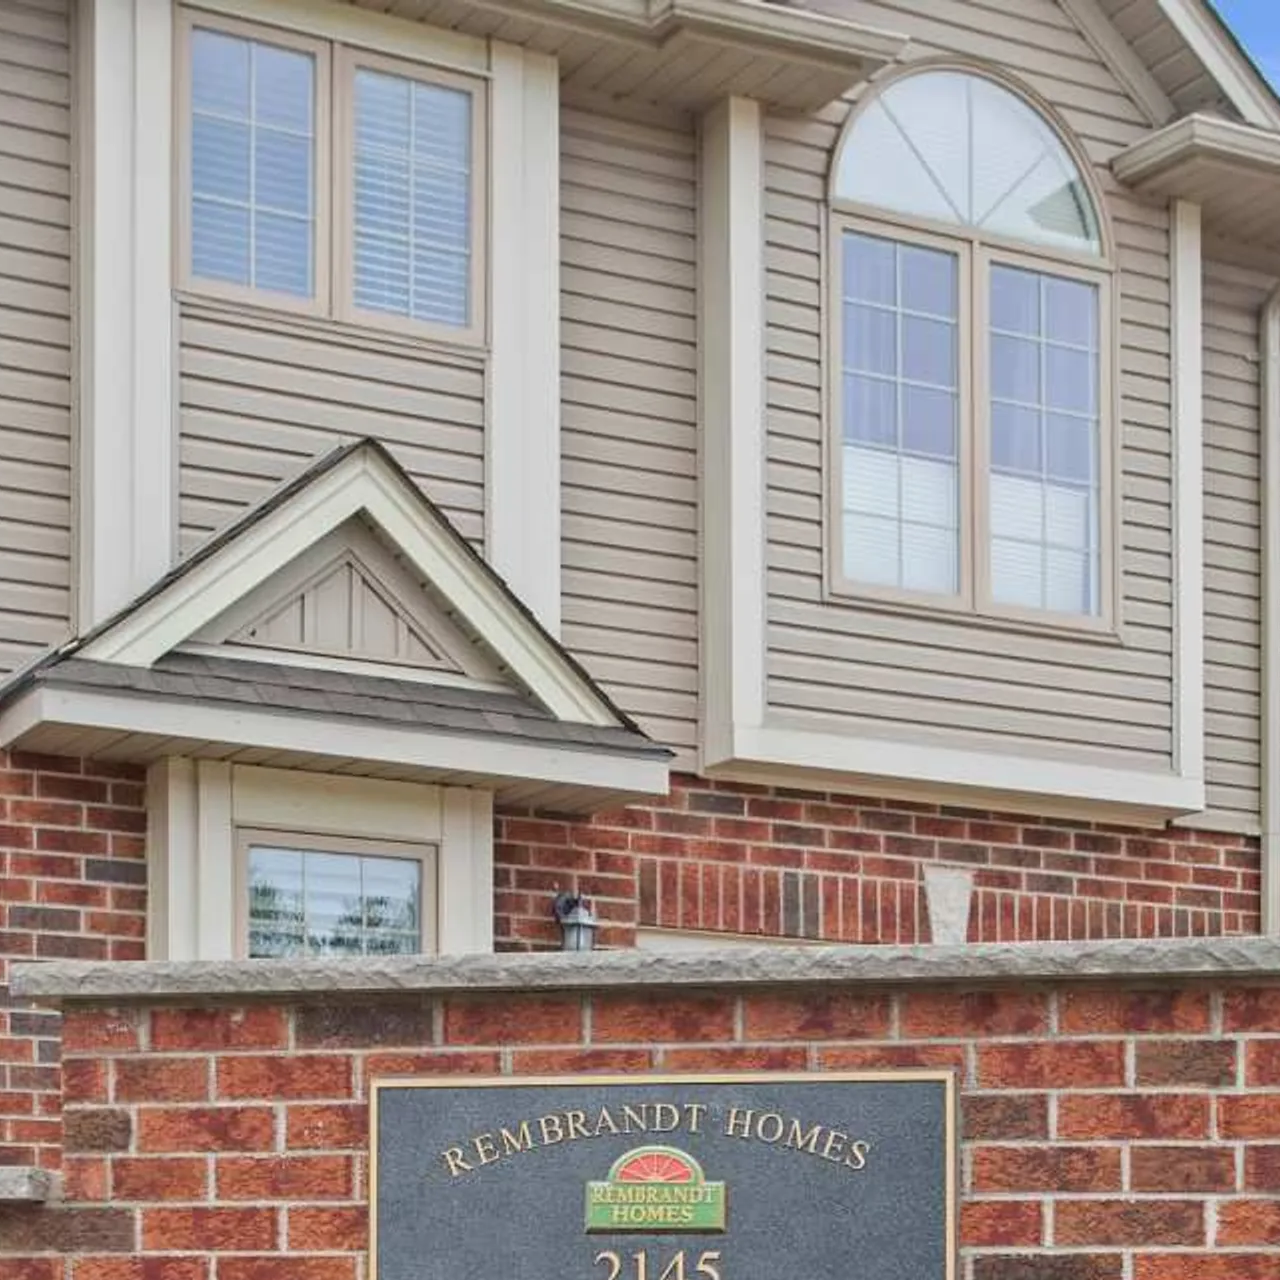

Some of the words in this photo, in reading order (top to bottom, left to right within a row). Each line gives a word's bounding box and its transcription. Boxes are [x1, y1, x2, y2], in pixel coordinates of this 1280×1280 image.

[441, 1103, 706, 1177] REMBRANDT
[725, 1107, 871, 1171] HOMES
[591, 1186, 714, 1203] REMBRANDT
[610, 1205, 694, 1223] HOMES
